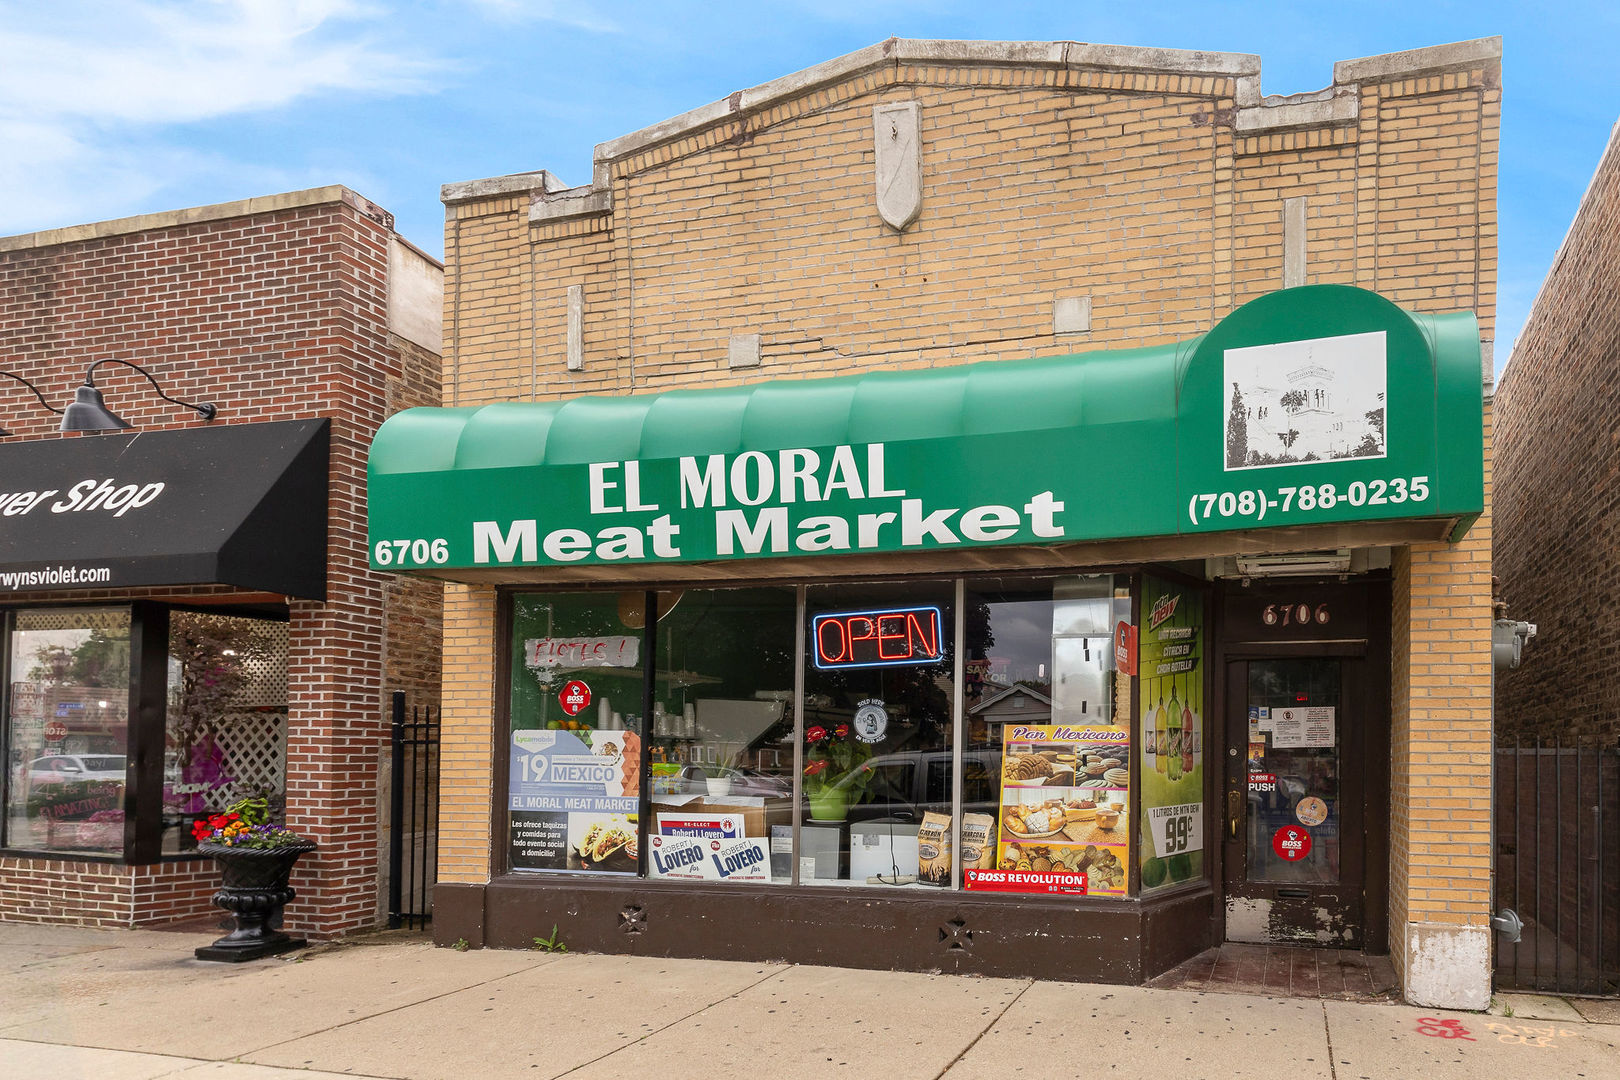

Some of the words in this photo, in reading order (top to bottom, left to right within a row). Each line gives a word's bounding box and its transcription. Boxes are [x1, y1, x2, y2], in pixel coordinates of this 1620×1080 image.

[589, 460, 659, 514] EL
[679, 443, 906, 509] MORAL
[51, 478, 165, 517] Shop
[1188, 476, 1430, 526] (708)-788-0235
[473, 513, 681, 564] Meat
[715, 490, 1066, 556] Market
[374, 537, 450, 566] 6706
[1262, 603, 1331, 627] 6706
[817, 612, 936, 662] OPEN
[516, 735, 554, 744] Lycamobile
[1013, 726, 1047, 740] Pan
[1052, 726, 1128, 741] Mexicano
[1248, 782, 1276, 792] PUSH
[512, 796, 524, 808] EL
[527, 798, 562, 808] MORAL
[564, 798, 592, 810] MEAT
[598, 799, 638, 810] MARKET
[672, 828, 694, 838] Robert
[701, 830, 724, 838] Lovero
[662, 840, 688, 854] ROBERT
[720, 841, 748, 858] ROBERT
[652, 845, 704, 874] LOVERO
[712, 846, 764, 878] LOVERO
[977, 872, 1006, 882] BOSS
[1008, 873, 1082, 885] REVOLUTION
